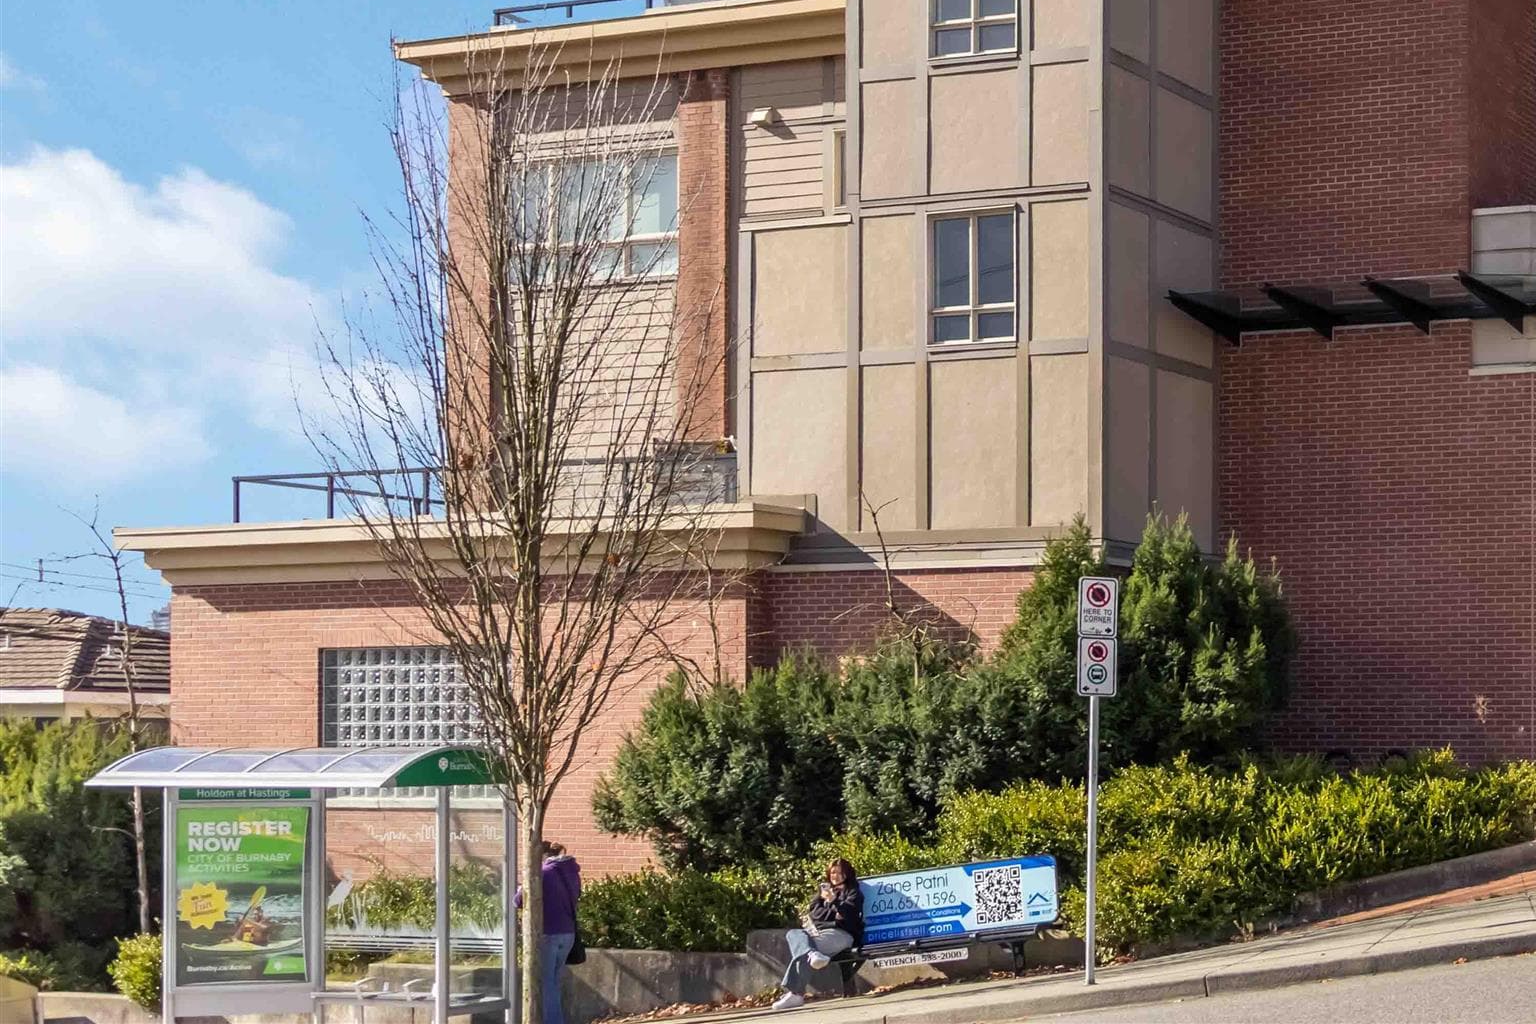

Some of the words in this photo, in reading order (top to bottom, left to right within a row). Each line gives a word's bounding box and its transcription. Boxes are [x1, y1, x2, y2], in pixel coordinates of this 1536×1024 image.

[1083, 608, 1101, 616] HERE
[1104, 608, 1113, 616] TO
[1083, 616, 1112, 624] CORNER
[196, 788, 234, 797] Holdom
[236, 788, 246, 797] at
[248, 787, 290, 799] Hastings
[187, 820, 292, 836] REGISTER
[188, 837, 242, 852] NOW
[187, 854, 213, 864] CITY
[217, 854, 233, 863] OF
[236, 853, 292, 862] BURNABY
[188, 863, 249, 872] ACTIVITIES
[877, 880, 912, 896] Zane
[915, 873, 949, 890] Patni
[871, 891, 957, 914] 604.657.1596
[873, 957, 916, 968] KEYBENCH
